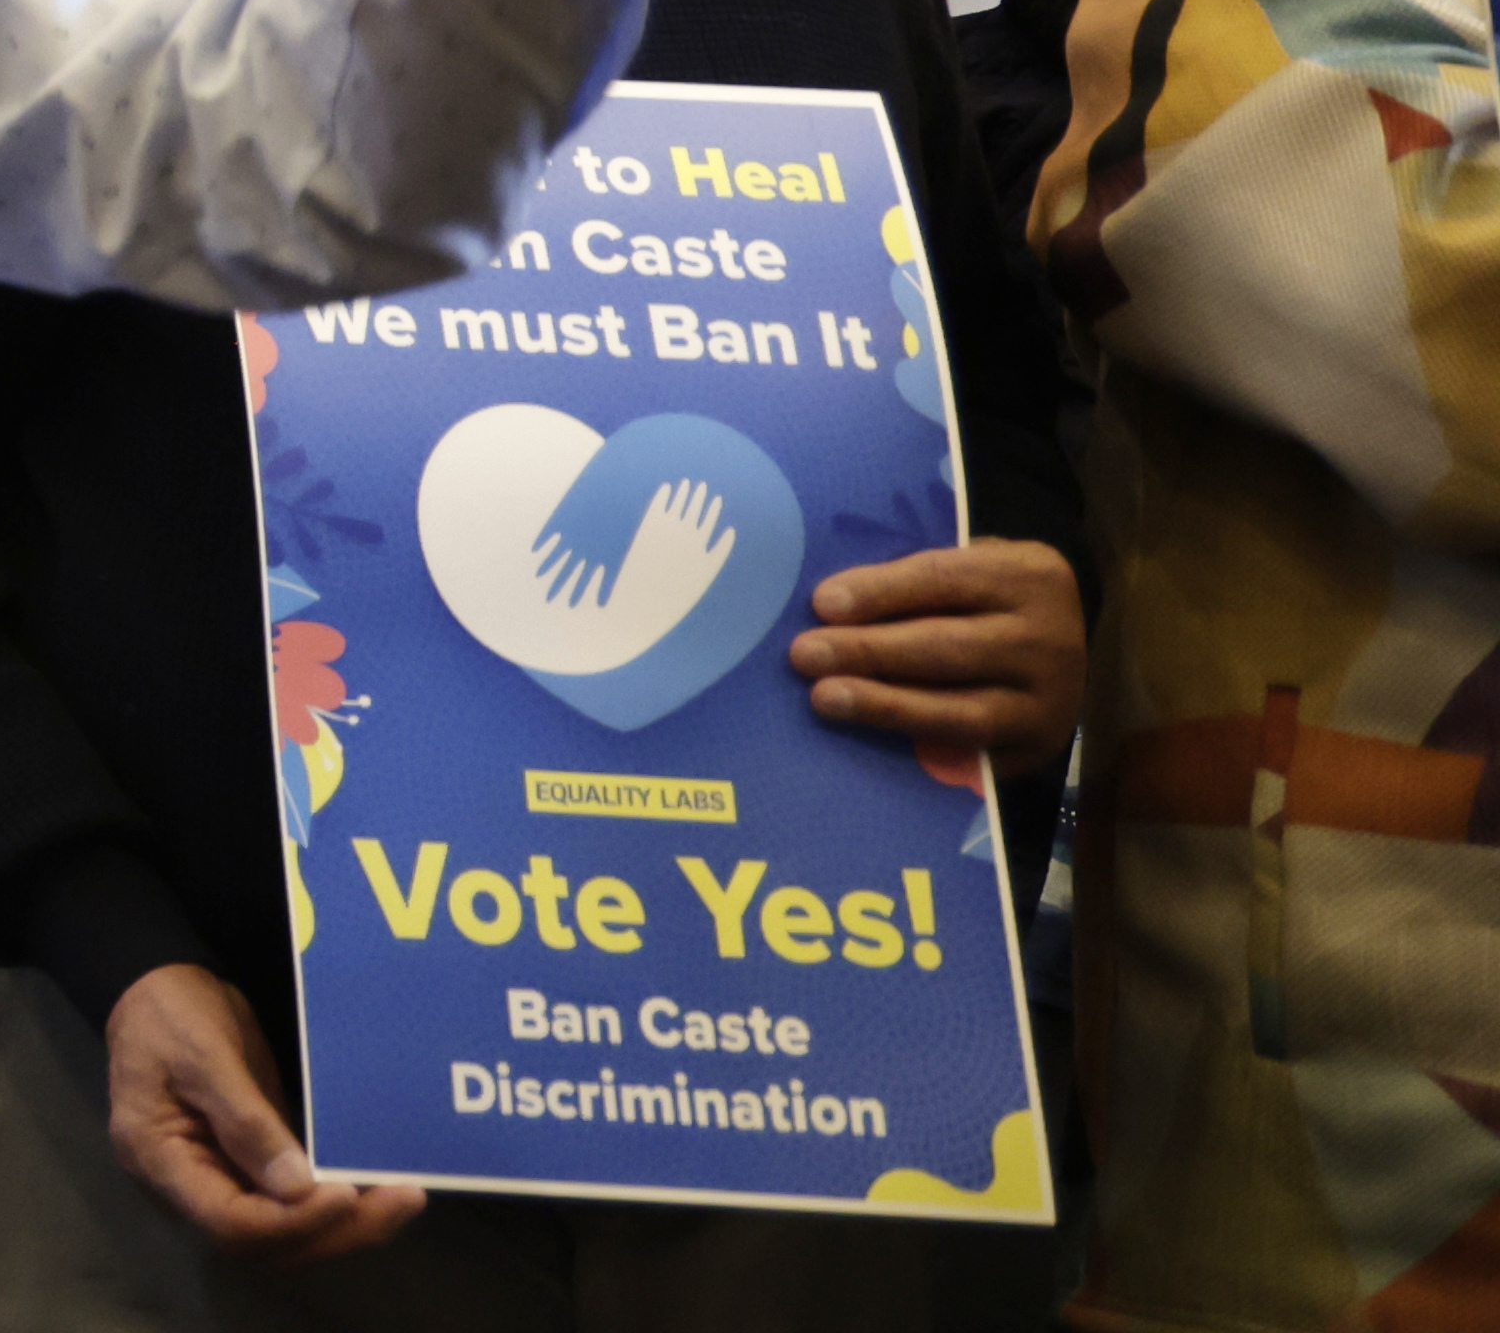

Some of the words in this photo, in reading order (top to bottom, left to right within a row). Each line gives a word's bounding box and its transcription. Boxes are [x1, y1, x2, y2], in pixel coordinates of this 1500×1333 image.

[572, 146, 651, 196] to
[669, 146, 847, 204] Heal
[571, 219, 788, 282] Caste
[305, 298, 418, 348] We
[440, 305, 632, 358] must
[648, 303, 799, 366] Ban
[818, 311, 878, 371] It
[534, 780, 651, 808] EQUALITY
[660, 787, 726, 812] LABS
[351, 837, 646, 954] Vote
[675, 856, 943, 971] Yes!
[507, 987, 623, 1046] Ban
[639, 996, 811, 1056] Caste
[451, 1061, 888, 1138] Discrimination
